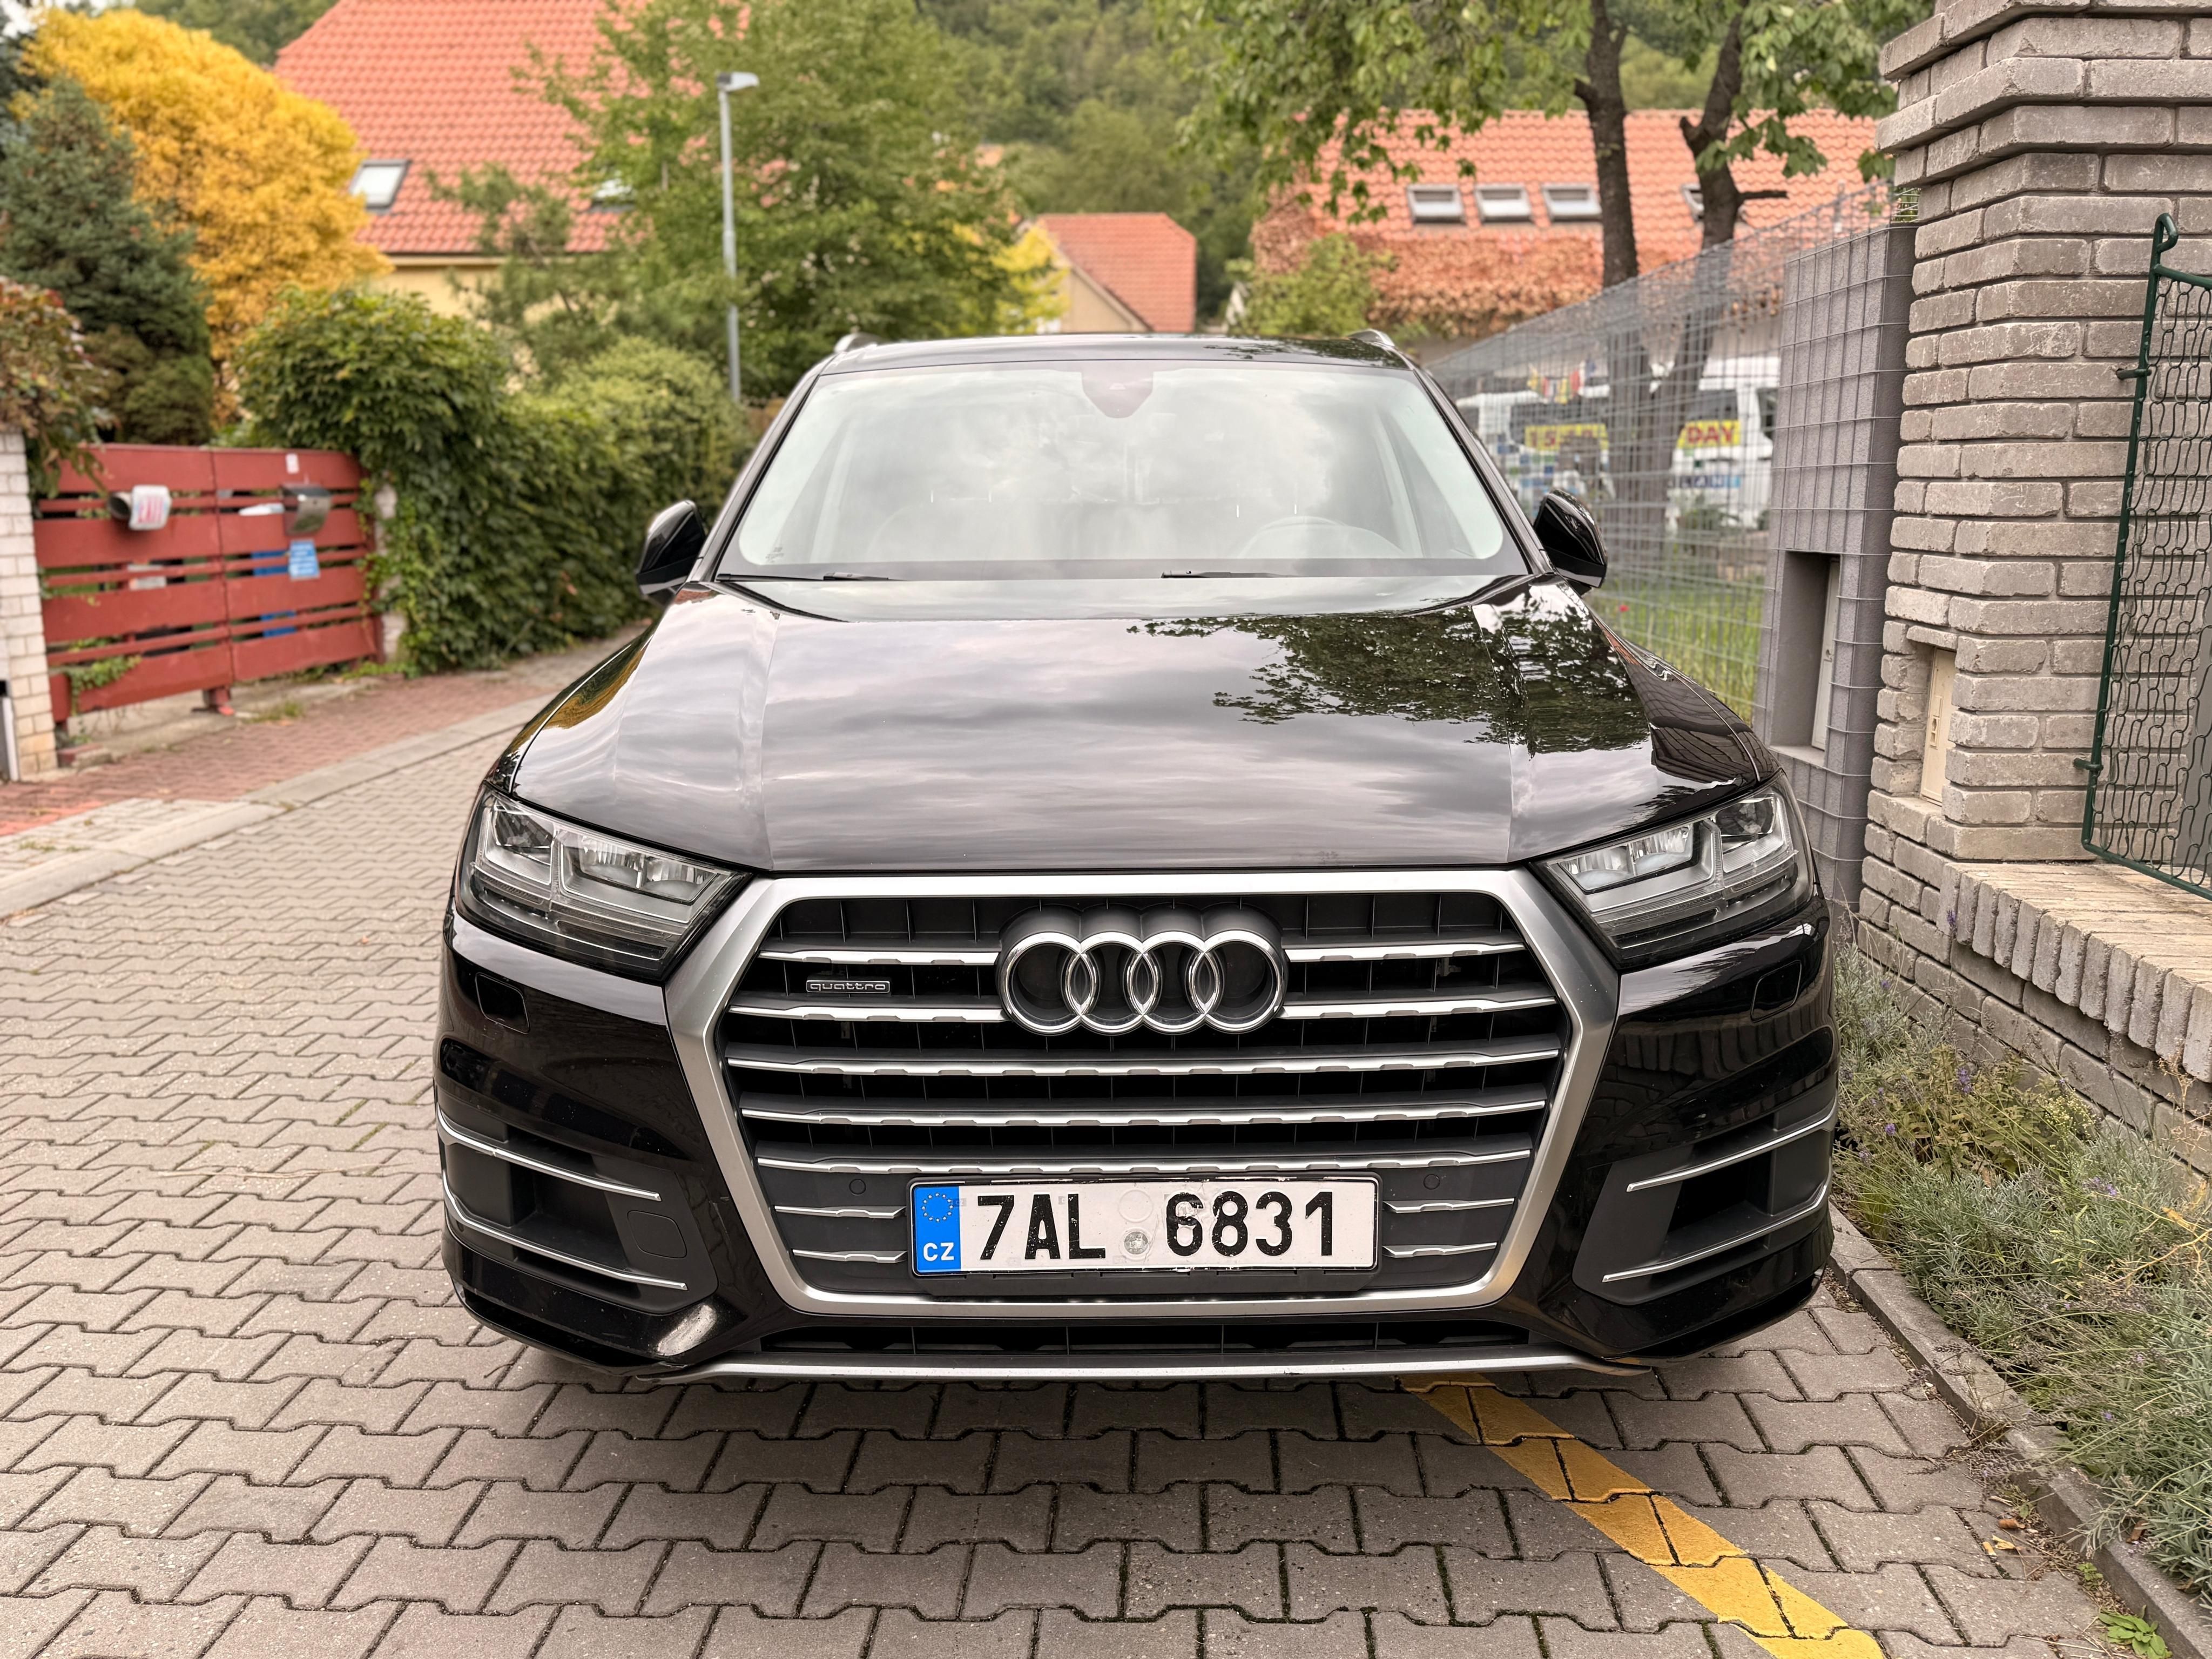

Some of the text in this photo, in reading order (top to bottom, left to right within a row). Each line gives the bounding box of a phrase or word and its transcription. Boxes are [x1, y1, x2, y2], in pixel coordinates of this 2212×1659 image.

[1688, 425, 1735, 444] DAY
[810, 982, 886, 991] quattro
[977, 1191, 1333, 1260] 7AL 6831
[923, 1242, 955, 1262] CZ
